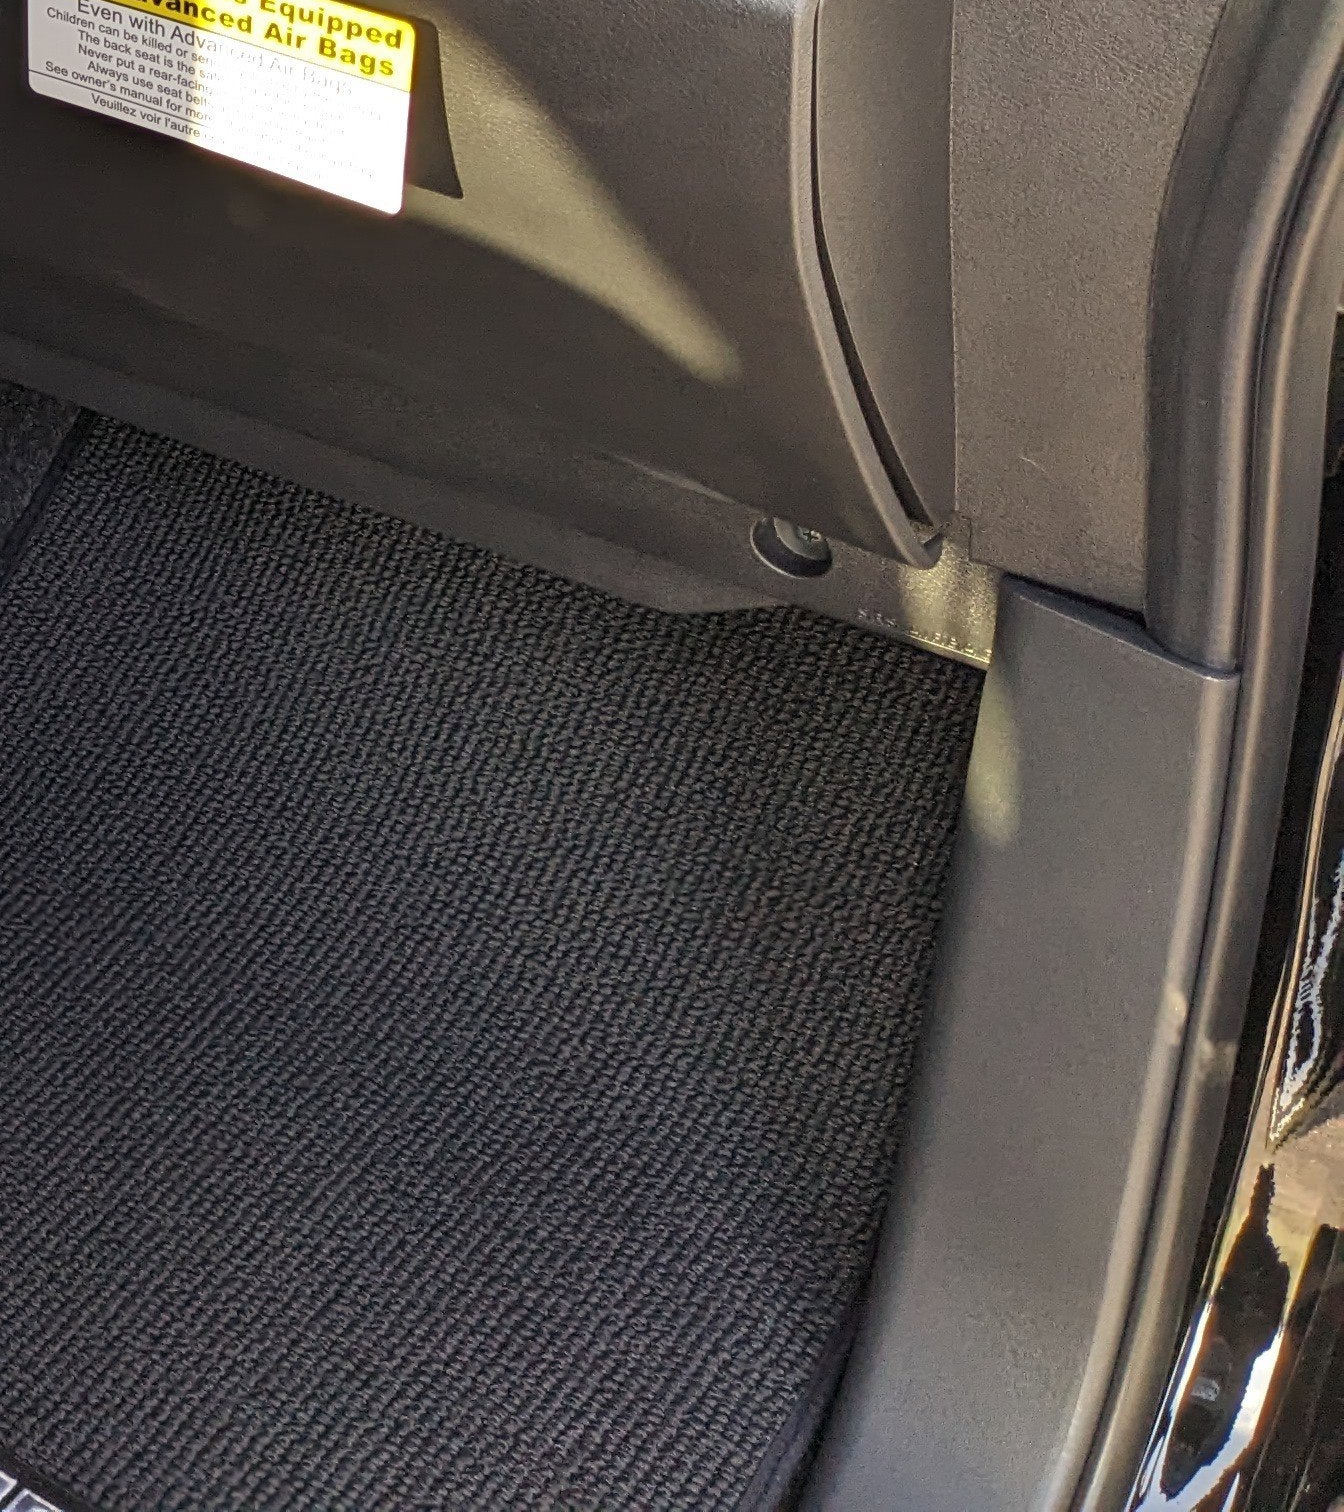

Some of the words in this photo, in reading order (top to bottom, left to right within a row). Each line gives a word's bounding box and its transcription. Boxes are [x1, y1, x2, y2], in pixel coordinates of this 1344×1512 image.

[47, 6, 95, 30] Children
[98, 24, 120, 38] can
[123, 29, 138, 43] be
[141, 34, 172, 54] killed
[175, 47, 188, 59] or
[128, 14, 166, 38] with
[264, 22, 307, 49] Air
[319, 36, 394, 76] Bags
[78, 29, 100, 46] The
[103, 37, 131, 55] back
[135, 49, 160, 65] seat
[163, 55, 174, 68] is
[177, 60, 196, 75] the
[78, 43, 113, 63] Never
[116, 57, 135, 71] put
[138, 64, 145, 74] a
[45, 60, 69, 77] See
[71, 71, 117, 92] owner's
[120, 85, 163, 106] manual
[166, 98, 183, 113] for
[87, 60, 129, 82] Always
[132, 76, 154, 90] use
[157, 84, 183, 100] seat
[91, 92, 137, 117] Veuillez
[140, 110, 162, 124] voir
[164, 116, 201, 138] l'autre
